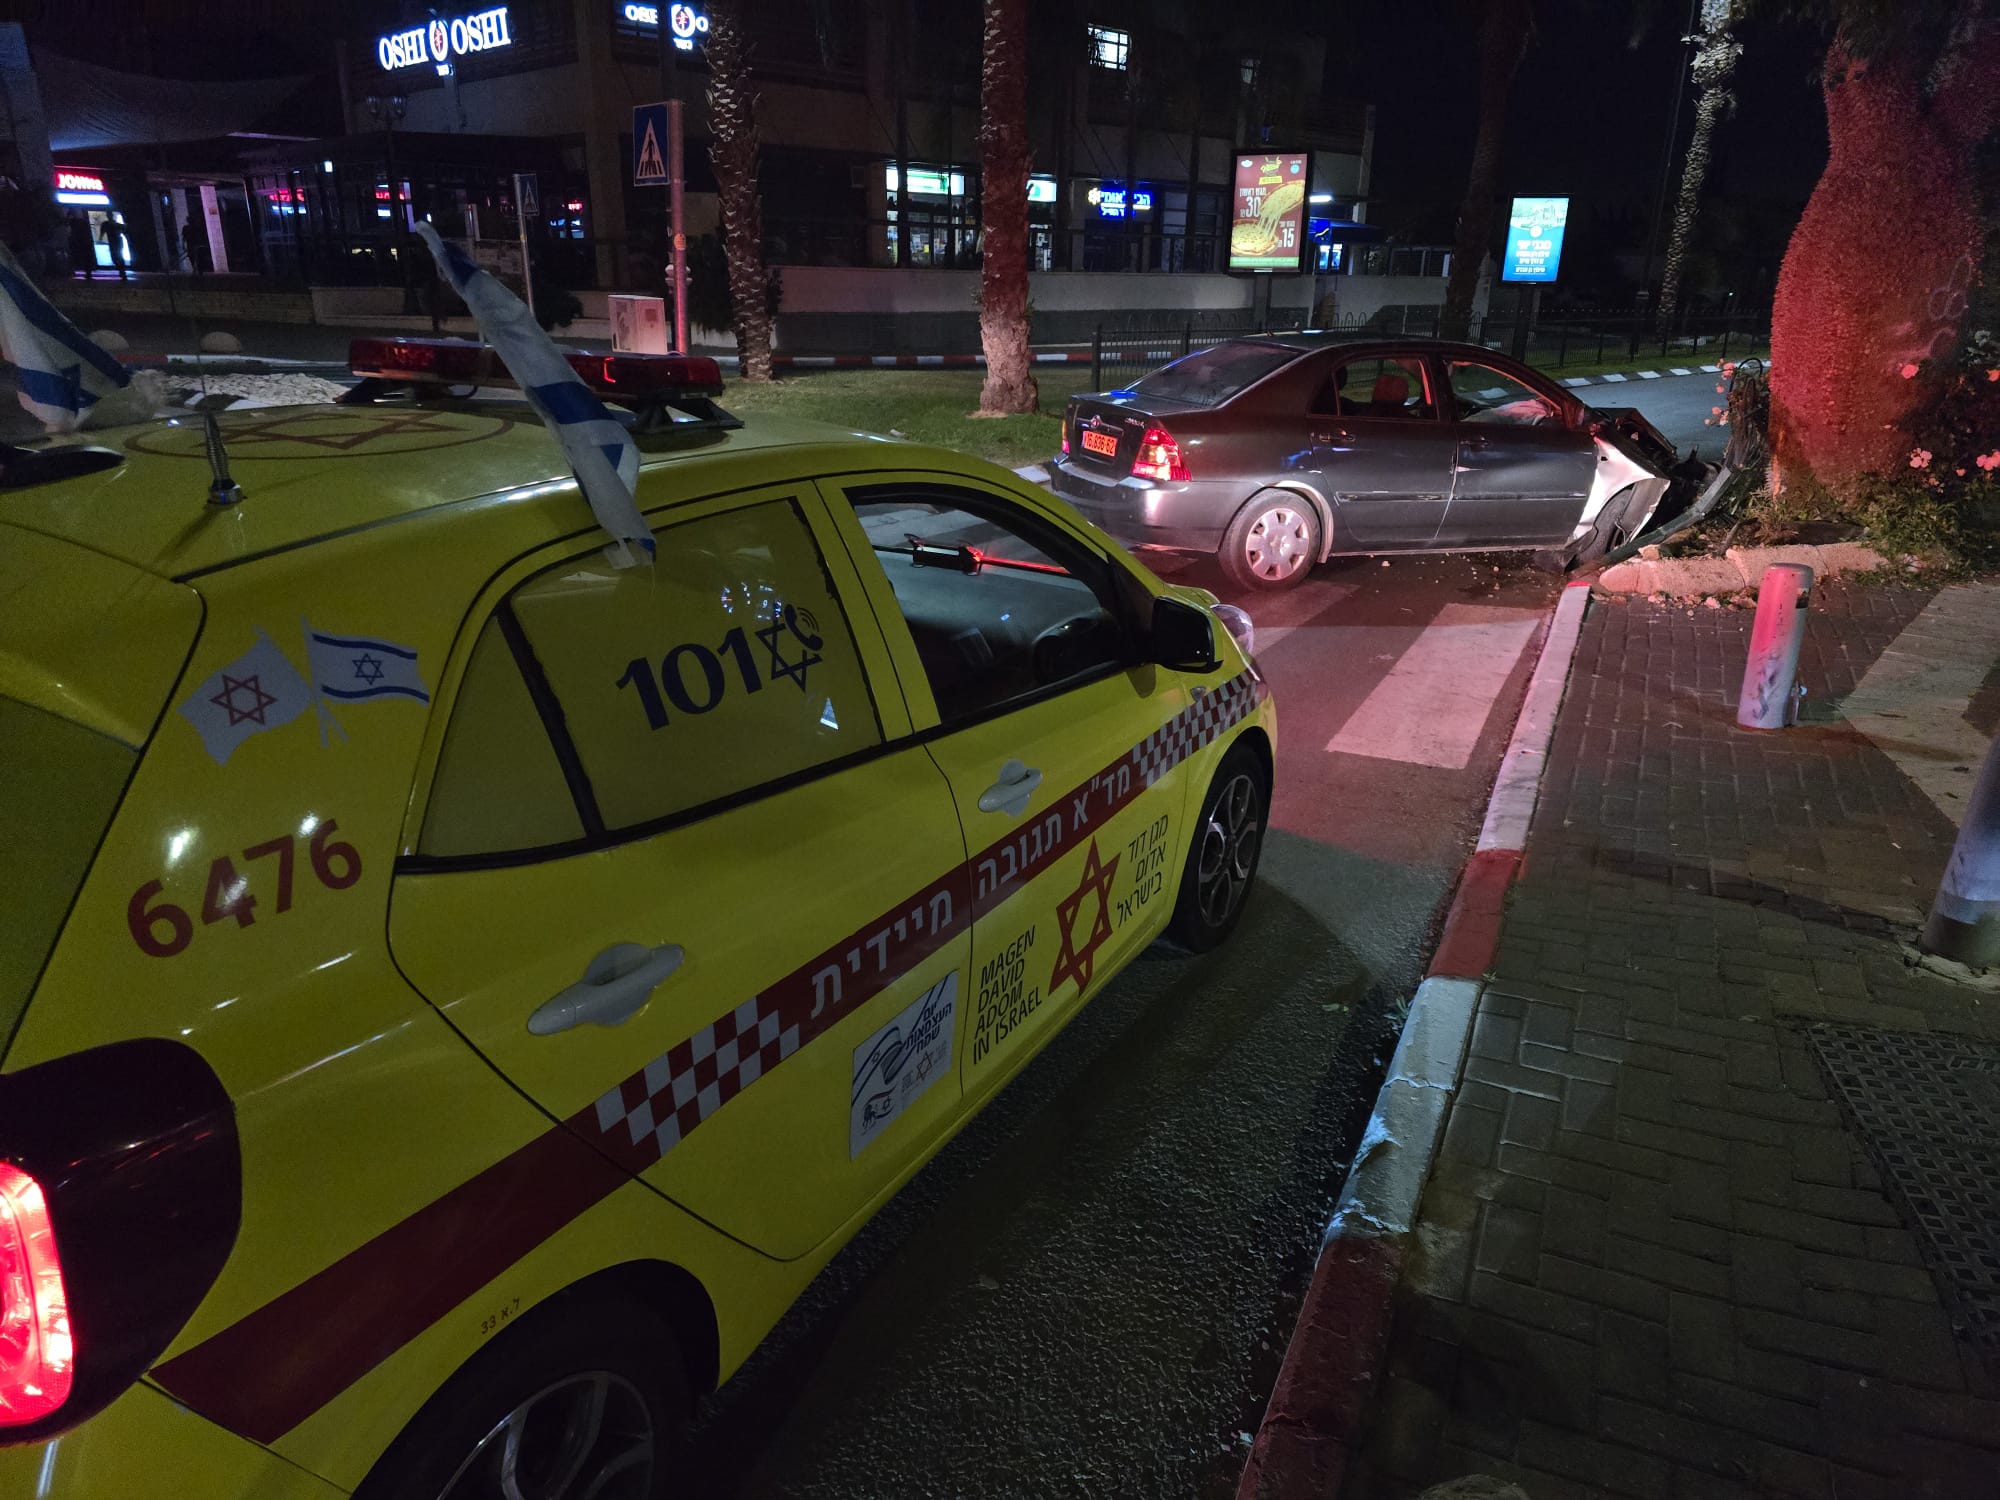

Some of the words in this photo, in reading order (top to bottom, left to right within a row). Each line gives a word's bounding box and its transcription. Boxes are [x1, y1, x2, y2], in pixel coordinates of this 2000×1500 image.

[379, 28, 429, 70] OSHI
[451, 8, 511, 55] OSHI
[1246, 196, 1261, 217] 30
[1282, 228, 1295, 248] 15
[615, 626, 762, 731] 101
[978, 813, 1062, 899] תגובה
[1128, 830, 1148, 863] דוד
[1149, 814, 1169, 851] מגן
[127, 818, 362, 958] 6476
[1135, 841, 1167, 884] אדום
[1117, 871, 1162, 928] בישראל
[810, 889, 953, 1020] מיידית
[980, 924, 1036, 989] MAGEN
[923, 1002, 937, 1022] יום
[974, 980, 1023, 1040] ADOM
[978, 958, 1025, 1014] DAVID
[917, 1024, 940, 1053] שמח
[973, 1031, 990, 1065] IN
[995, 986, 1042, 1045] ISRAEL
[481, 1315, 497, 1335] 33
